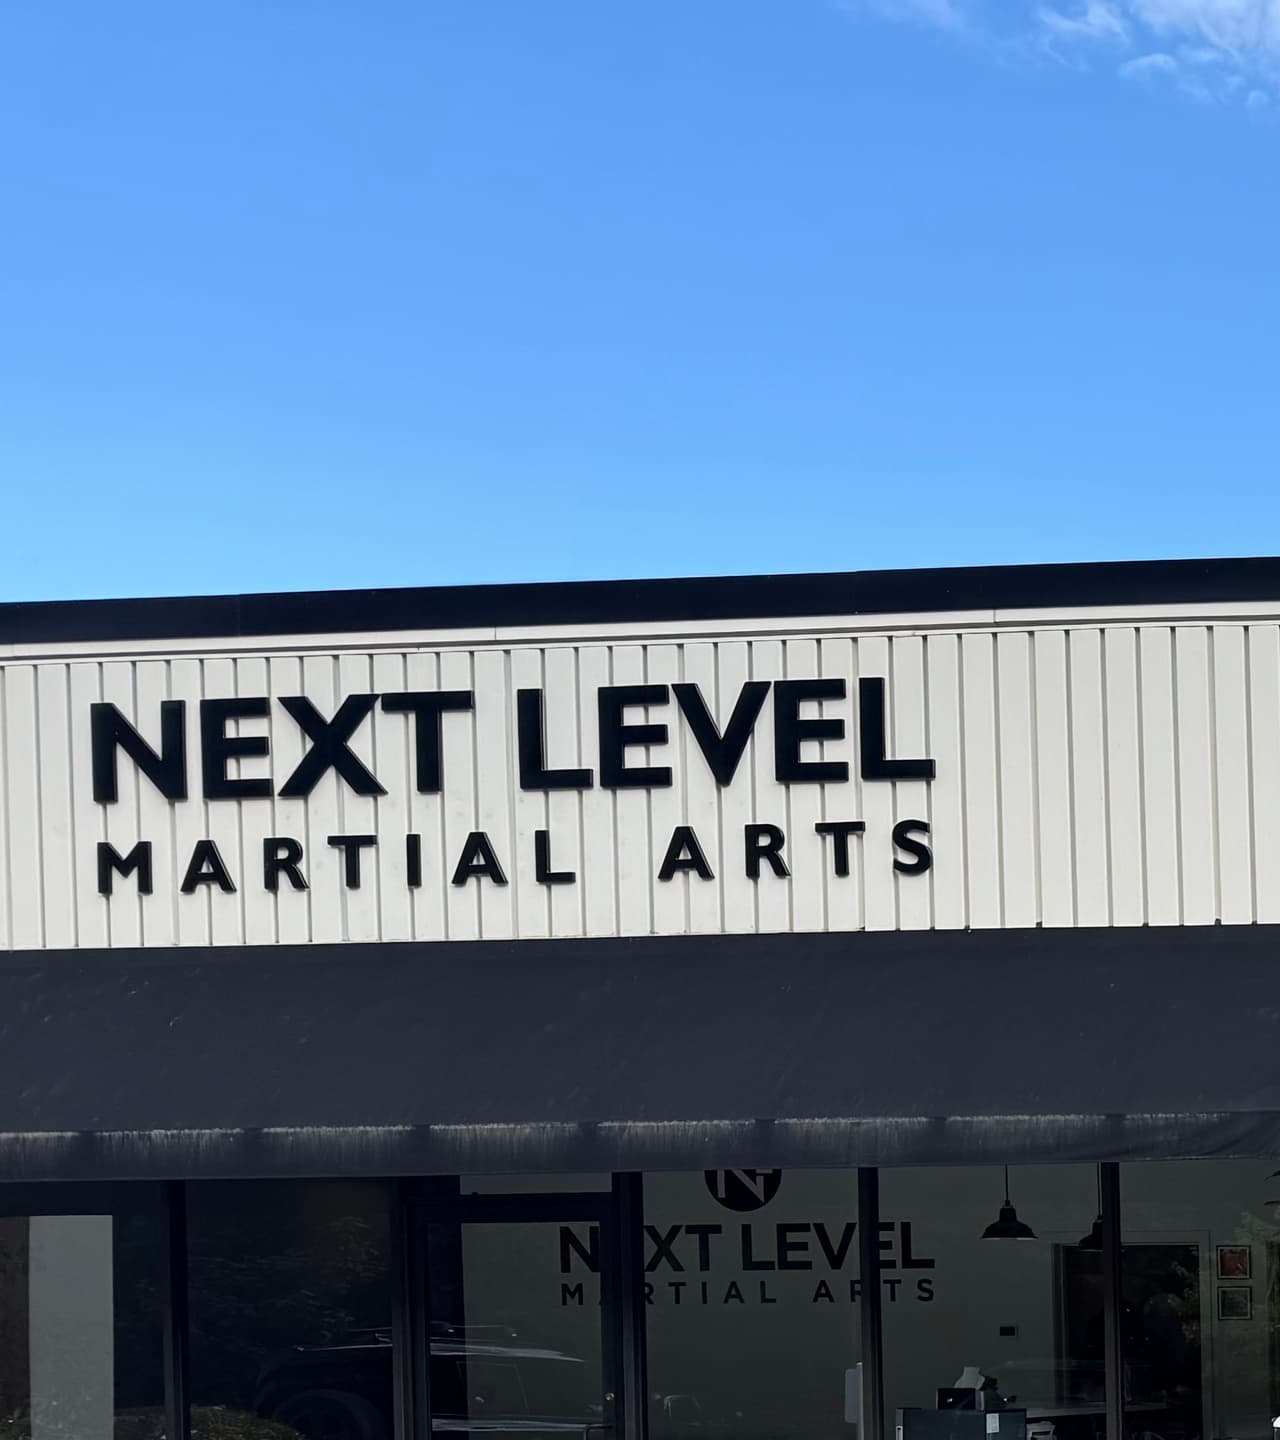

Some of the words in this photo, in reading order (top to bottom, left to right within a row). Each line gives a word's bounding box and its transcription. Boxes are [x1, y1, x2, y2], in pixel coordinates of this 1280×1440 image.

[91, 690, 474, 802] NEXT
[518, 677, 936, 791] LEVEL
[97, 830, 576, 895] MARTIAL
[658, 820, 934, 880] ARTS
[560, 1223, 722, 1273] NXT
[741, 1221, 935, 1270] LEVEL
[561, 1280, 776, 1305] MRTIAL
